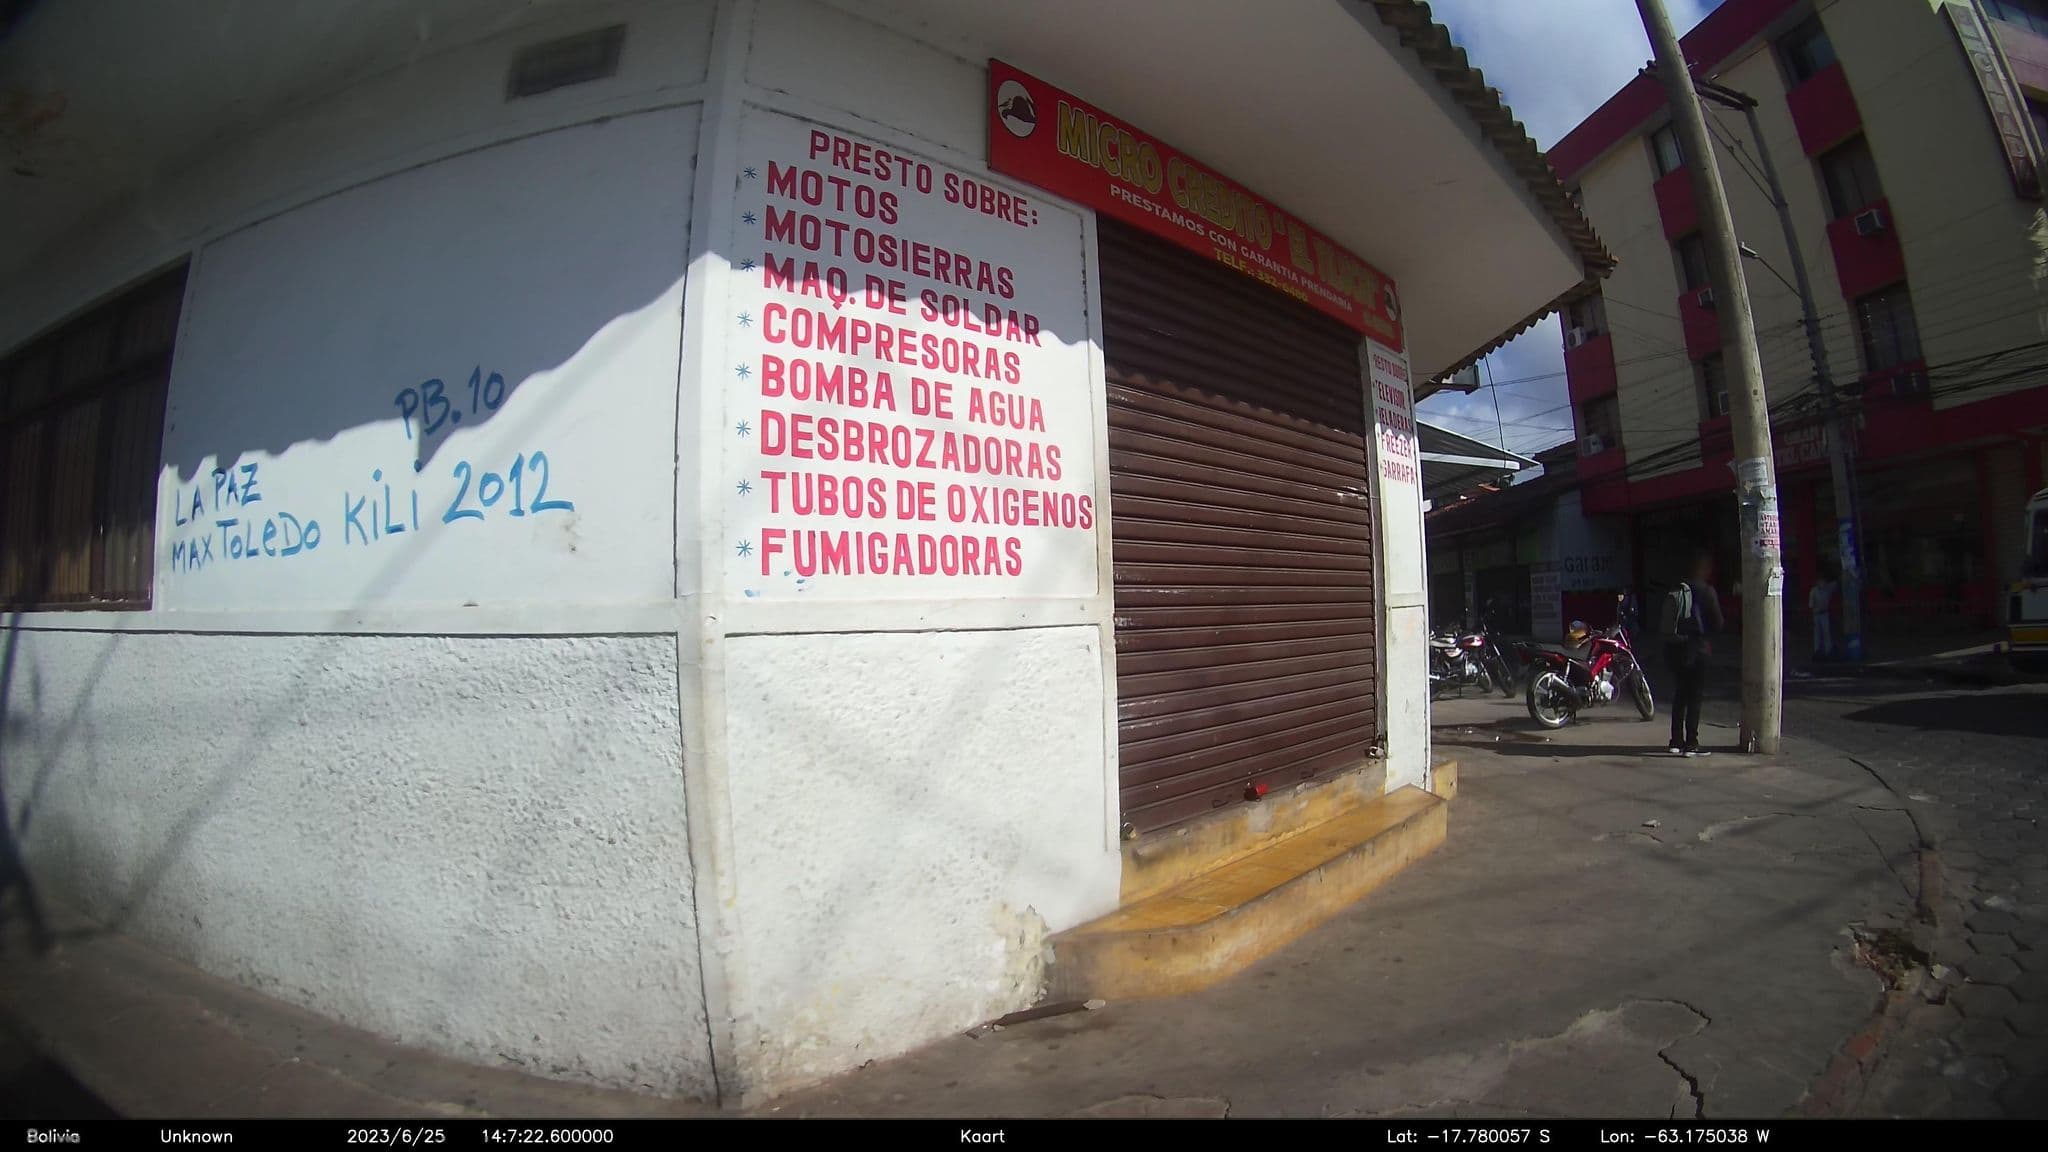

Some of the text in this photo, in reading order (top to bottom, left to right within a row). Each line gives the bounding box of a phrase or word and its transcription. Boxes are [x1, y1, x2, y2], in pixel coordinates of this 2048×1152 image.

[767, 161, 898, 225] MOTOS
[810, 129, 1038, 227] PRESTO SOBRE:
[1057, 100, 1163, 194] MICRO
[1167, 157, 1272, 250] CREDITO
[765, 205, 1015, 299] MOTOSIERRAS
[1110, 184, 1205, 235] PRESTAMOS
[1209, 230, 1237, 251] CON
[1241, 246, 1298, 283] GARANTIA
[764, 252, 1042, 347] MAQ. DE SOLDAR
[762, 302, 1020, 384] COMPRESORAS
[761, 354, 1046, 432] BOMBA DE AGUA
[760, 409, 1062, 481] DESBROZADORAS
[172, 534, 214, 573] MAX
[442, 450, 575, 524] 2012
[175, 463, 262, 526] LA PAZ
[761, 471, 1093, 530] TUBOS DE OXIGENOS
[761, 527, 1022, 576] FUMIGADORAS
